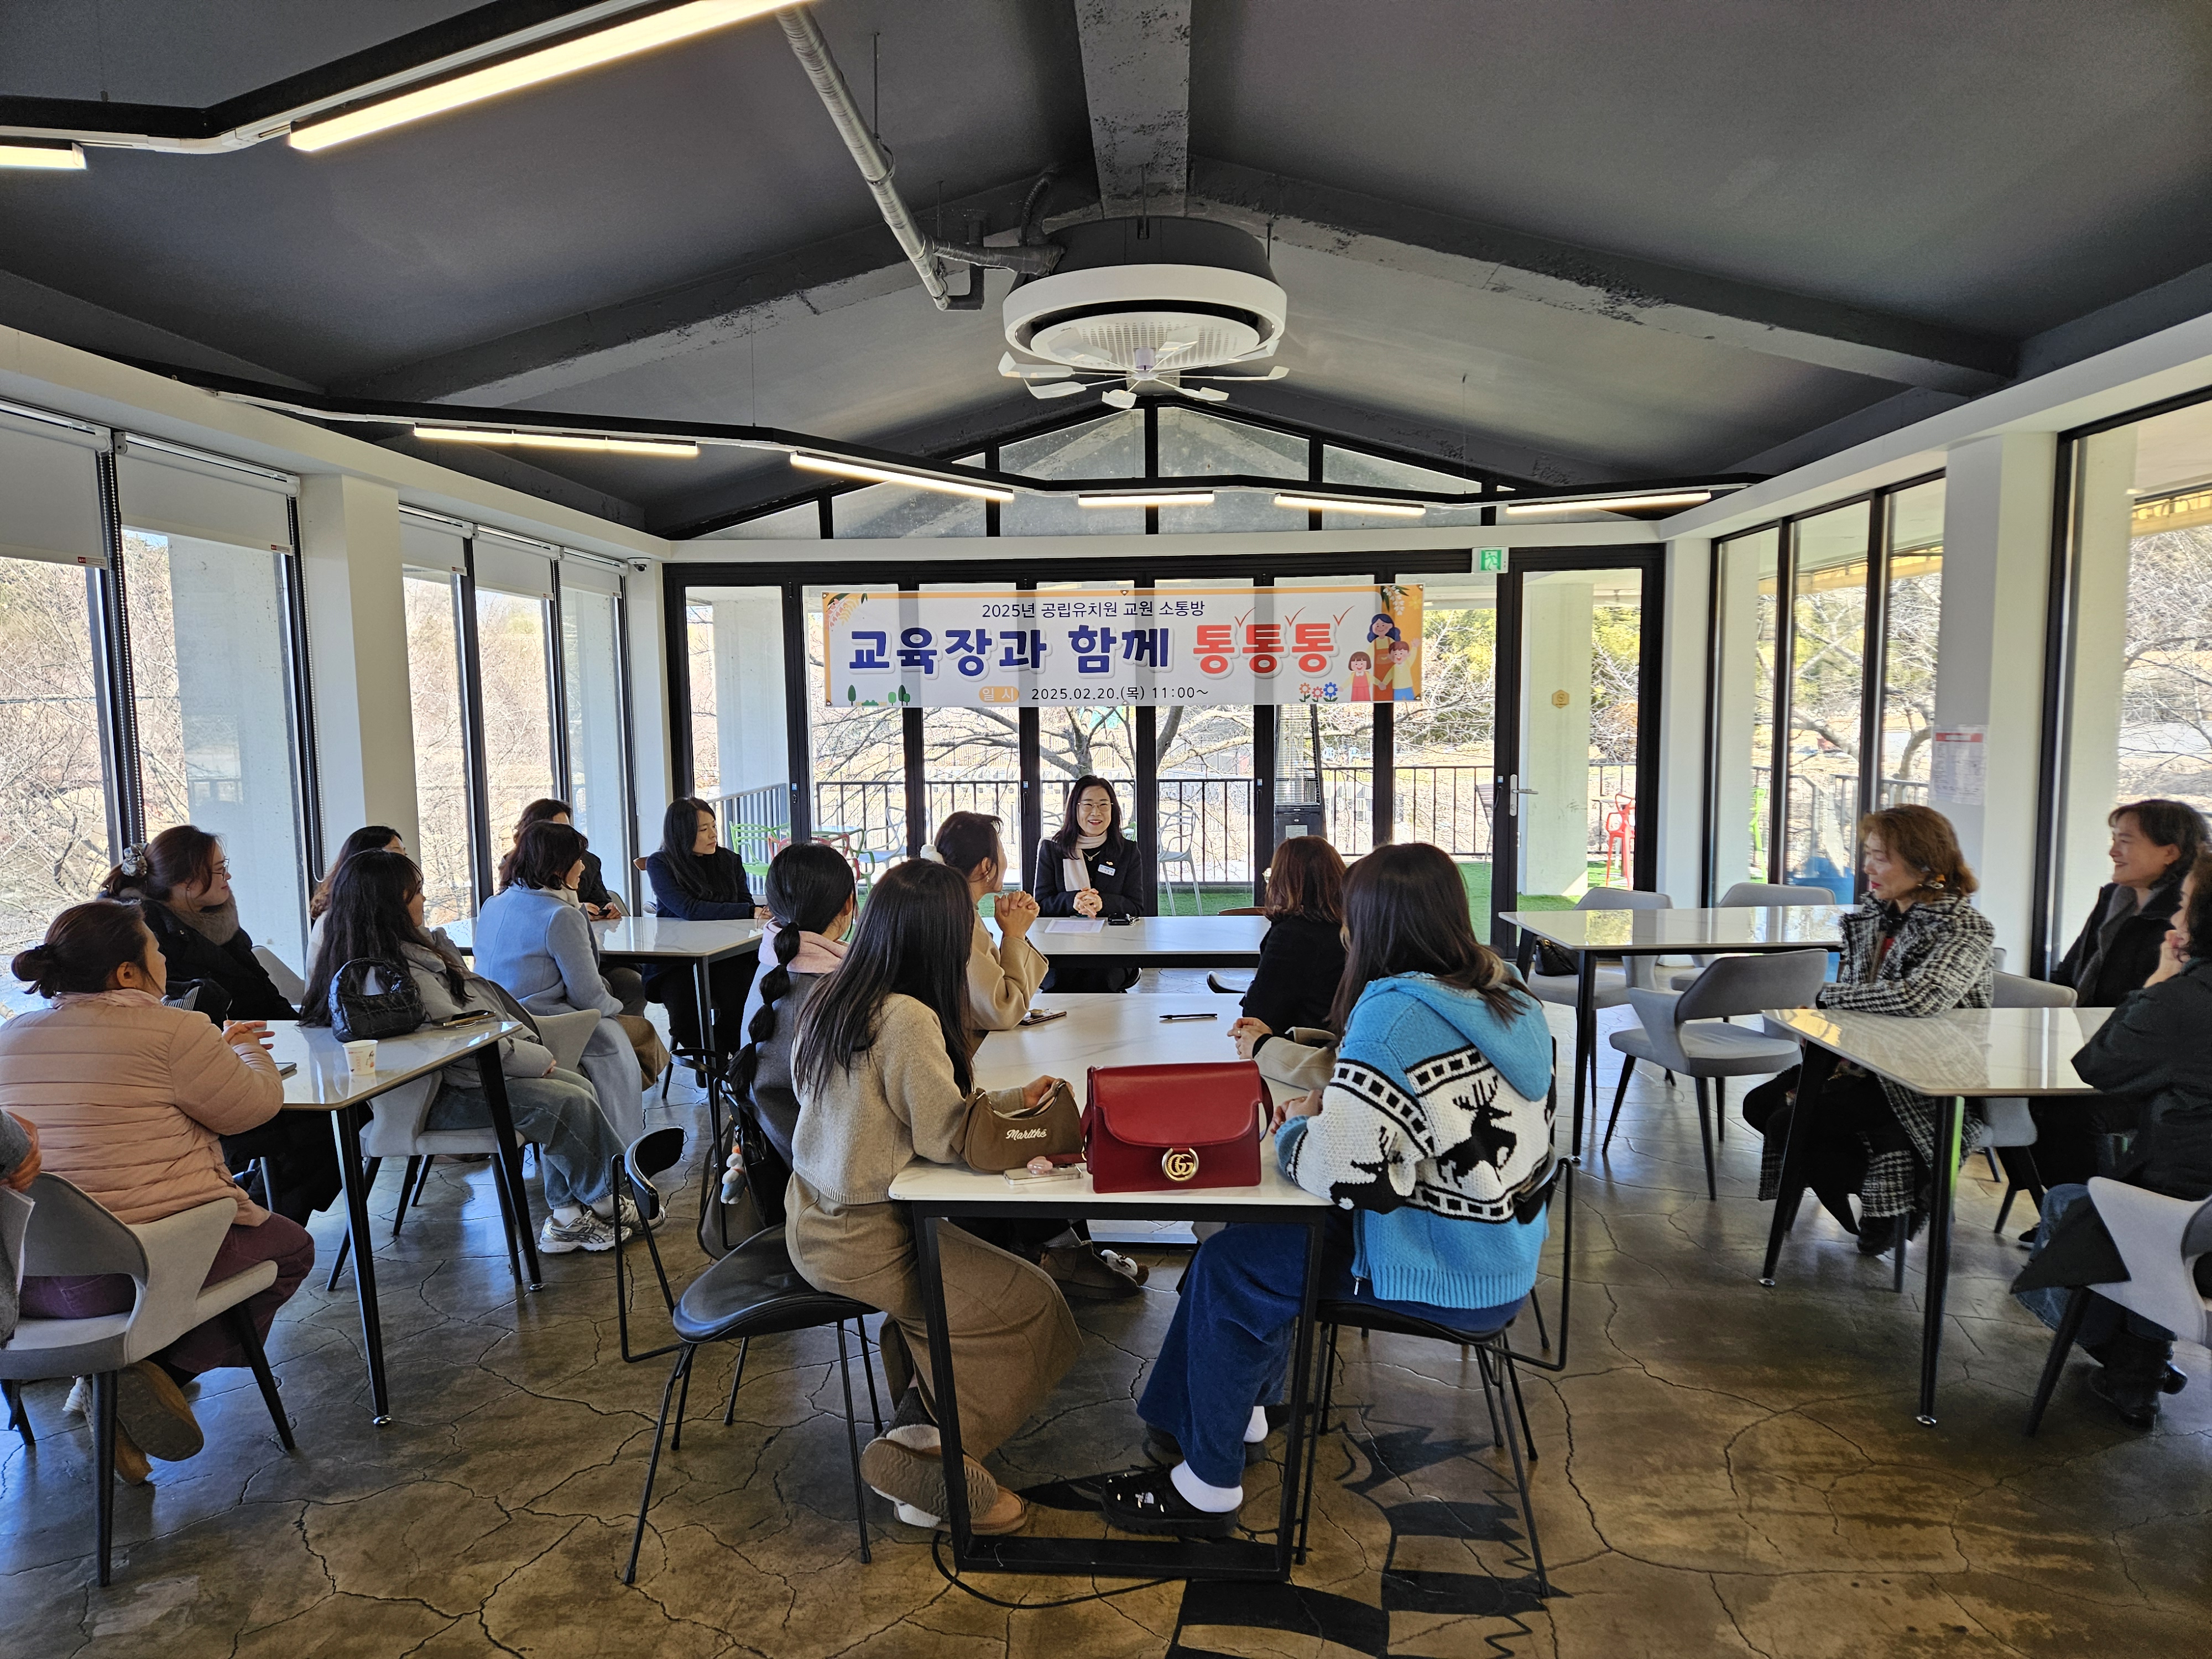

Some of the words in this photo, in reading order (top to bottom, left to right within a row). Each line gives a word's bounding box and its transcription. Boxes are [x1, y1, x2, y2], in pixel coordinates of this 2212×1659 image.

[982, 603, 1035, 618] 2025년
[1041, 602, 1118, 618] 공립유치원
[1123, 601, 1154, 617] 교원
[1159, 600, 1206, 617] 소통방
[849, 627, 1047, 676] 교육장과
[1068, 624, 1169, 673] 함께
[1193, 623, 1334, 674] 통통통
[982, 687, 995, 701] 일
[1001, 687, 1015, 701] 시
[1031, 686, 1145, 701] 2025.02.20.(목)
[1152, 686, 1209, 698] 11:00~
[1005, 1128, 1047, 1141] Marithé
